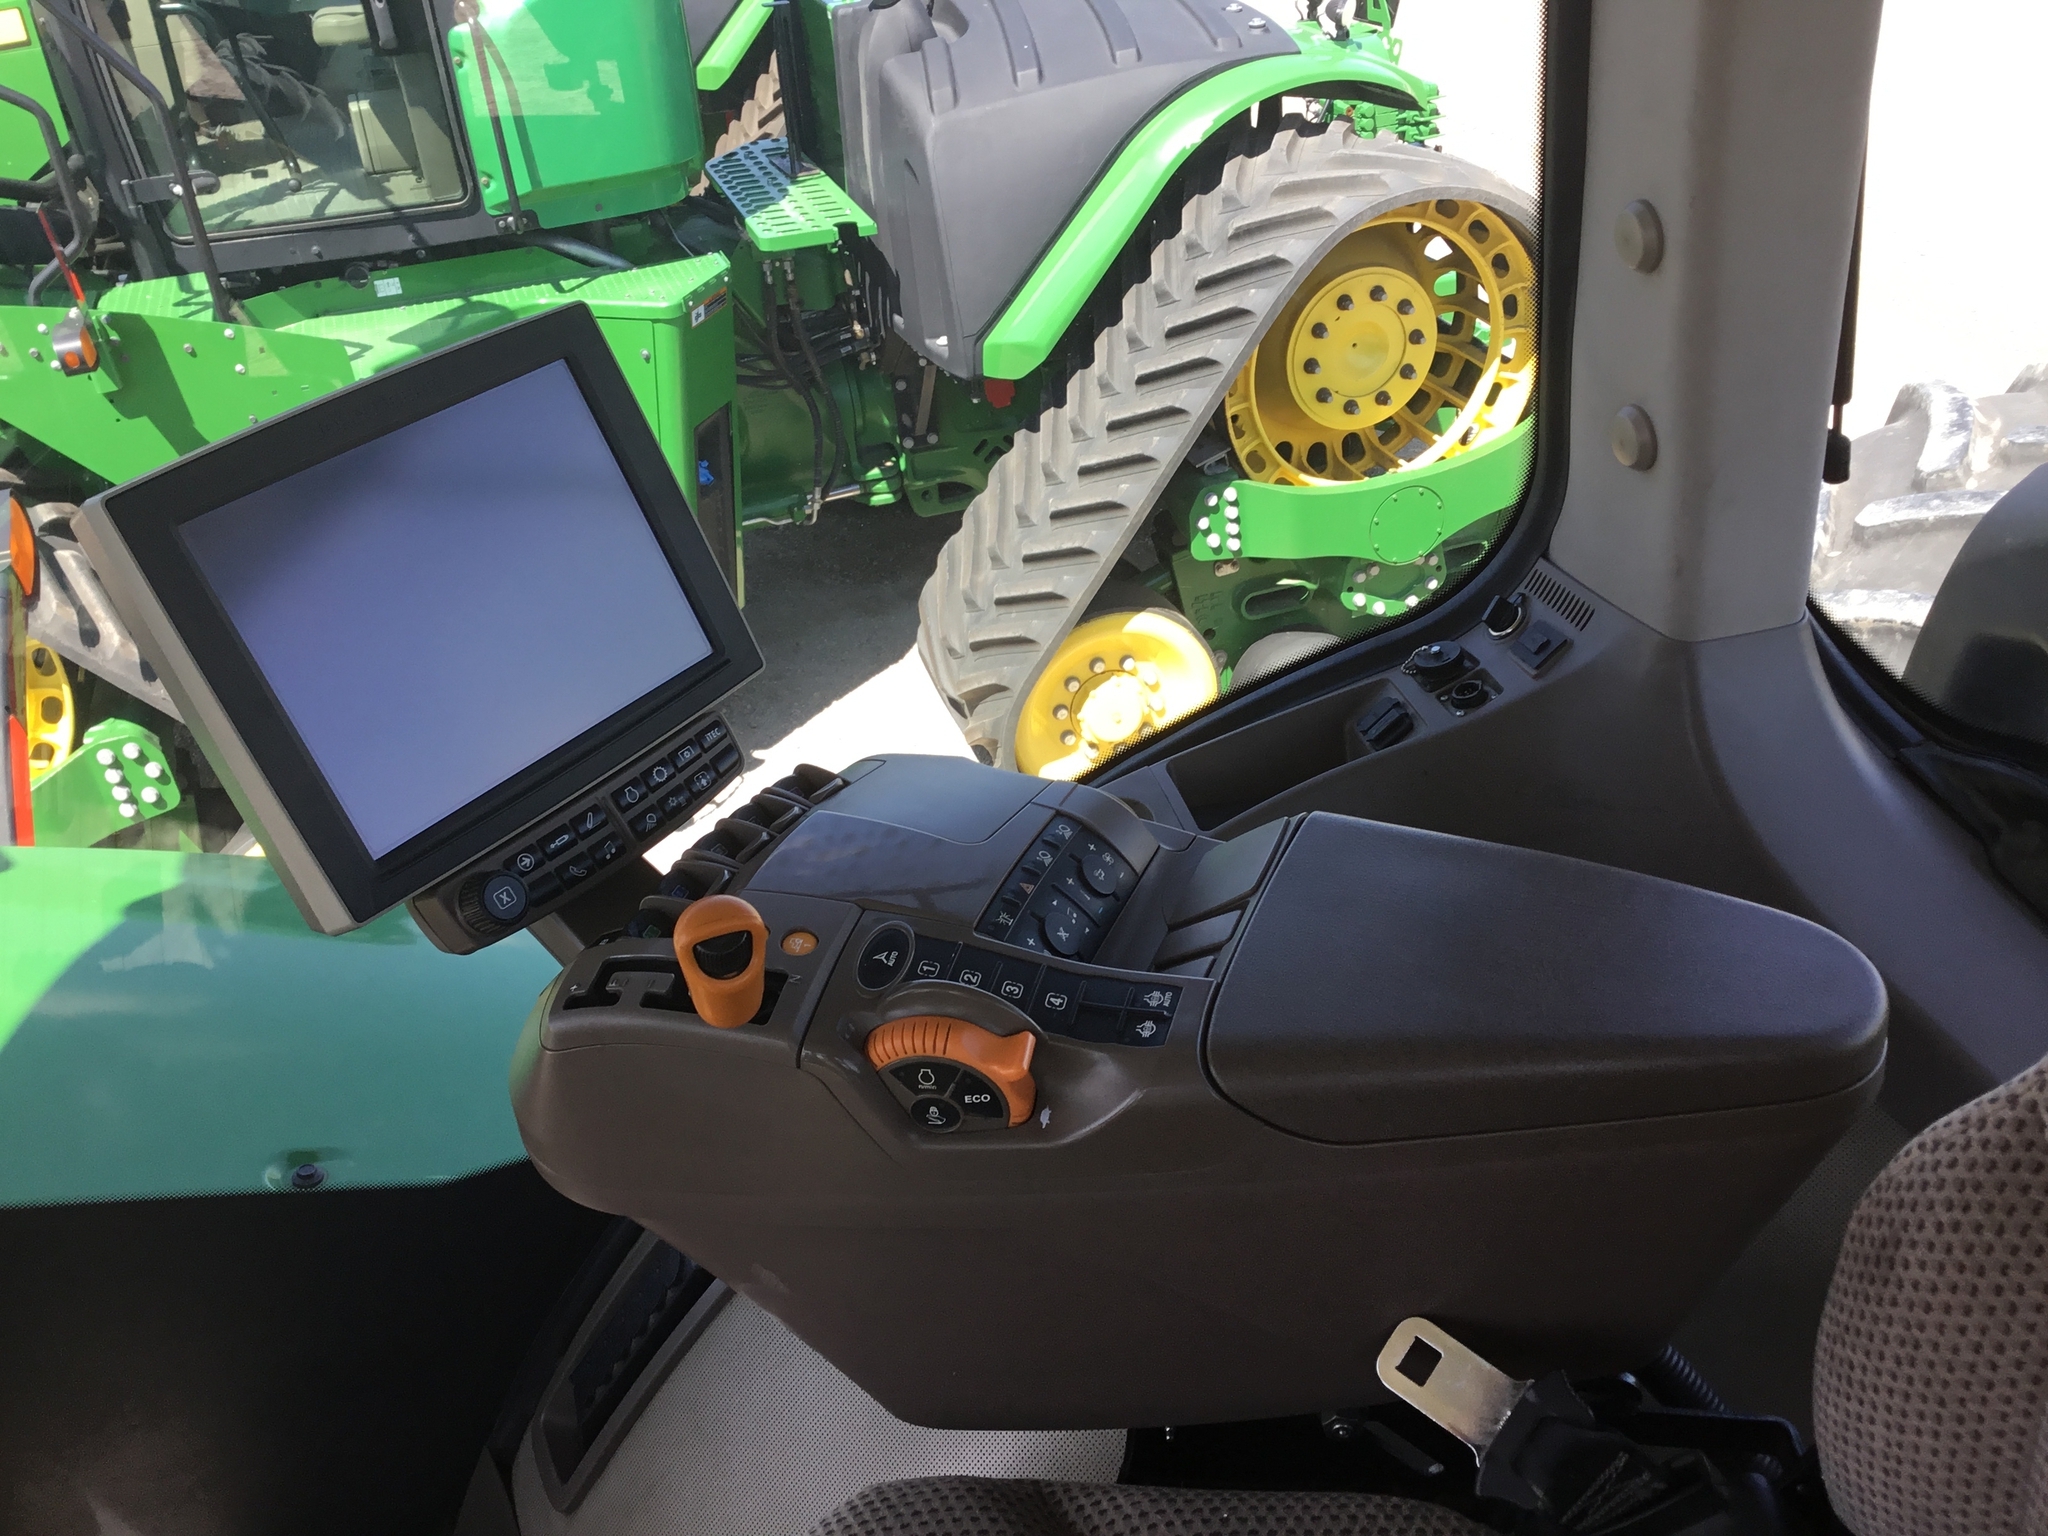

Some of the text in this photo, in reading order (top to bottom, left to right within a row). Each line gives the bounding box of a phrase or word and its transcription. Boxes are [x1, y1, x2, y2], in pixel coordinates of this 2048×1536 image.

[705, 727, 721, 742] iTEC
[887, 951, 898, 967] AUTO
[1049, 997, 1063, 1007] 4
[1163, 991, 1173, 1007] AUTO
[964, 1094, 990, 1104] ECO
